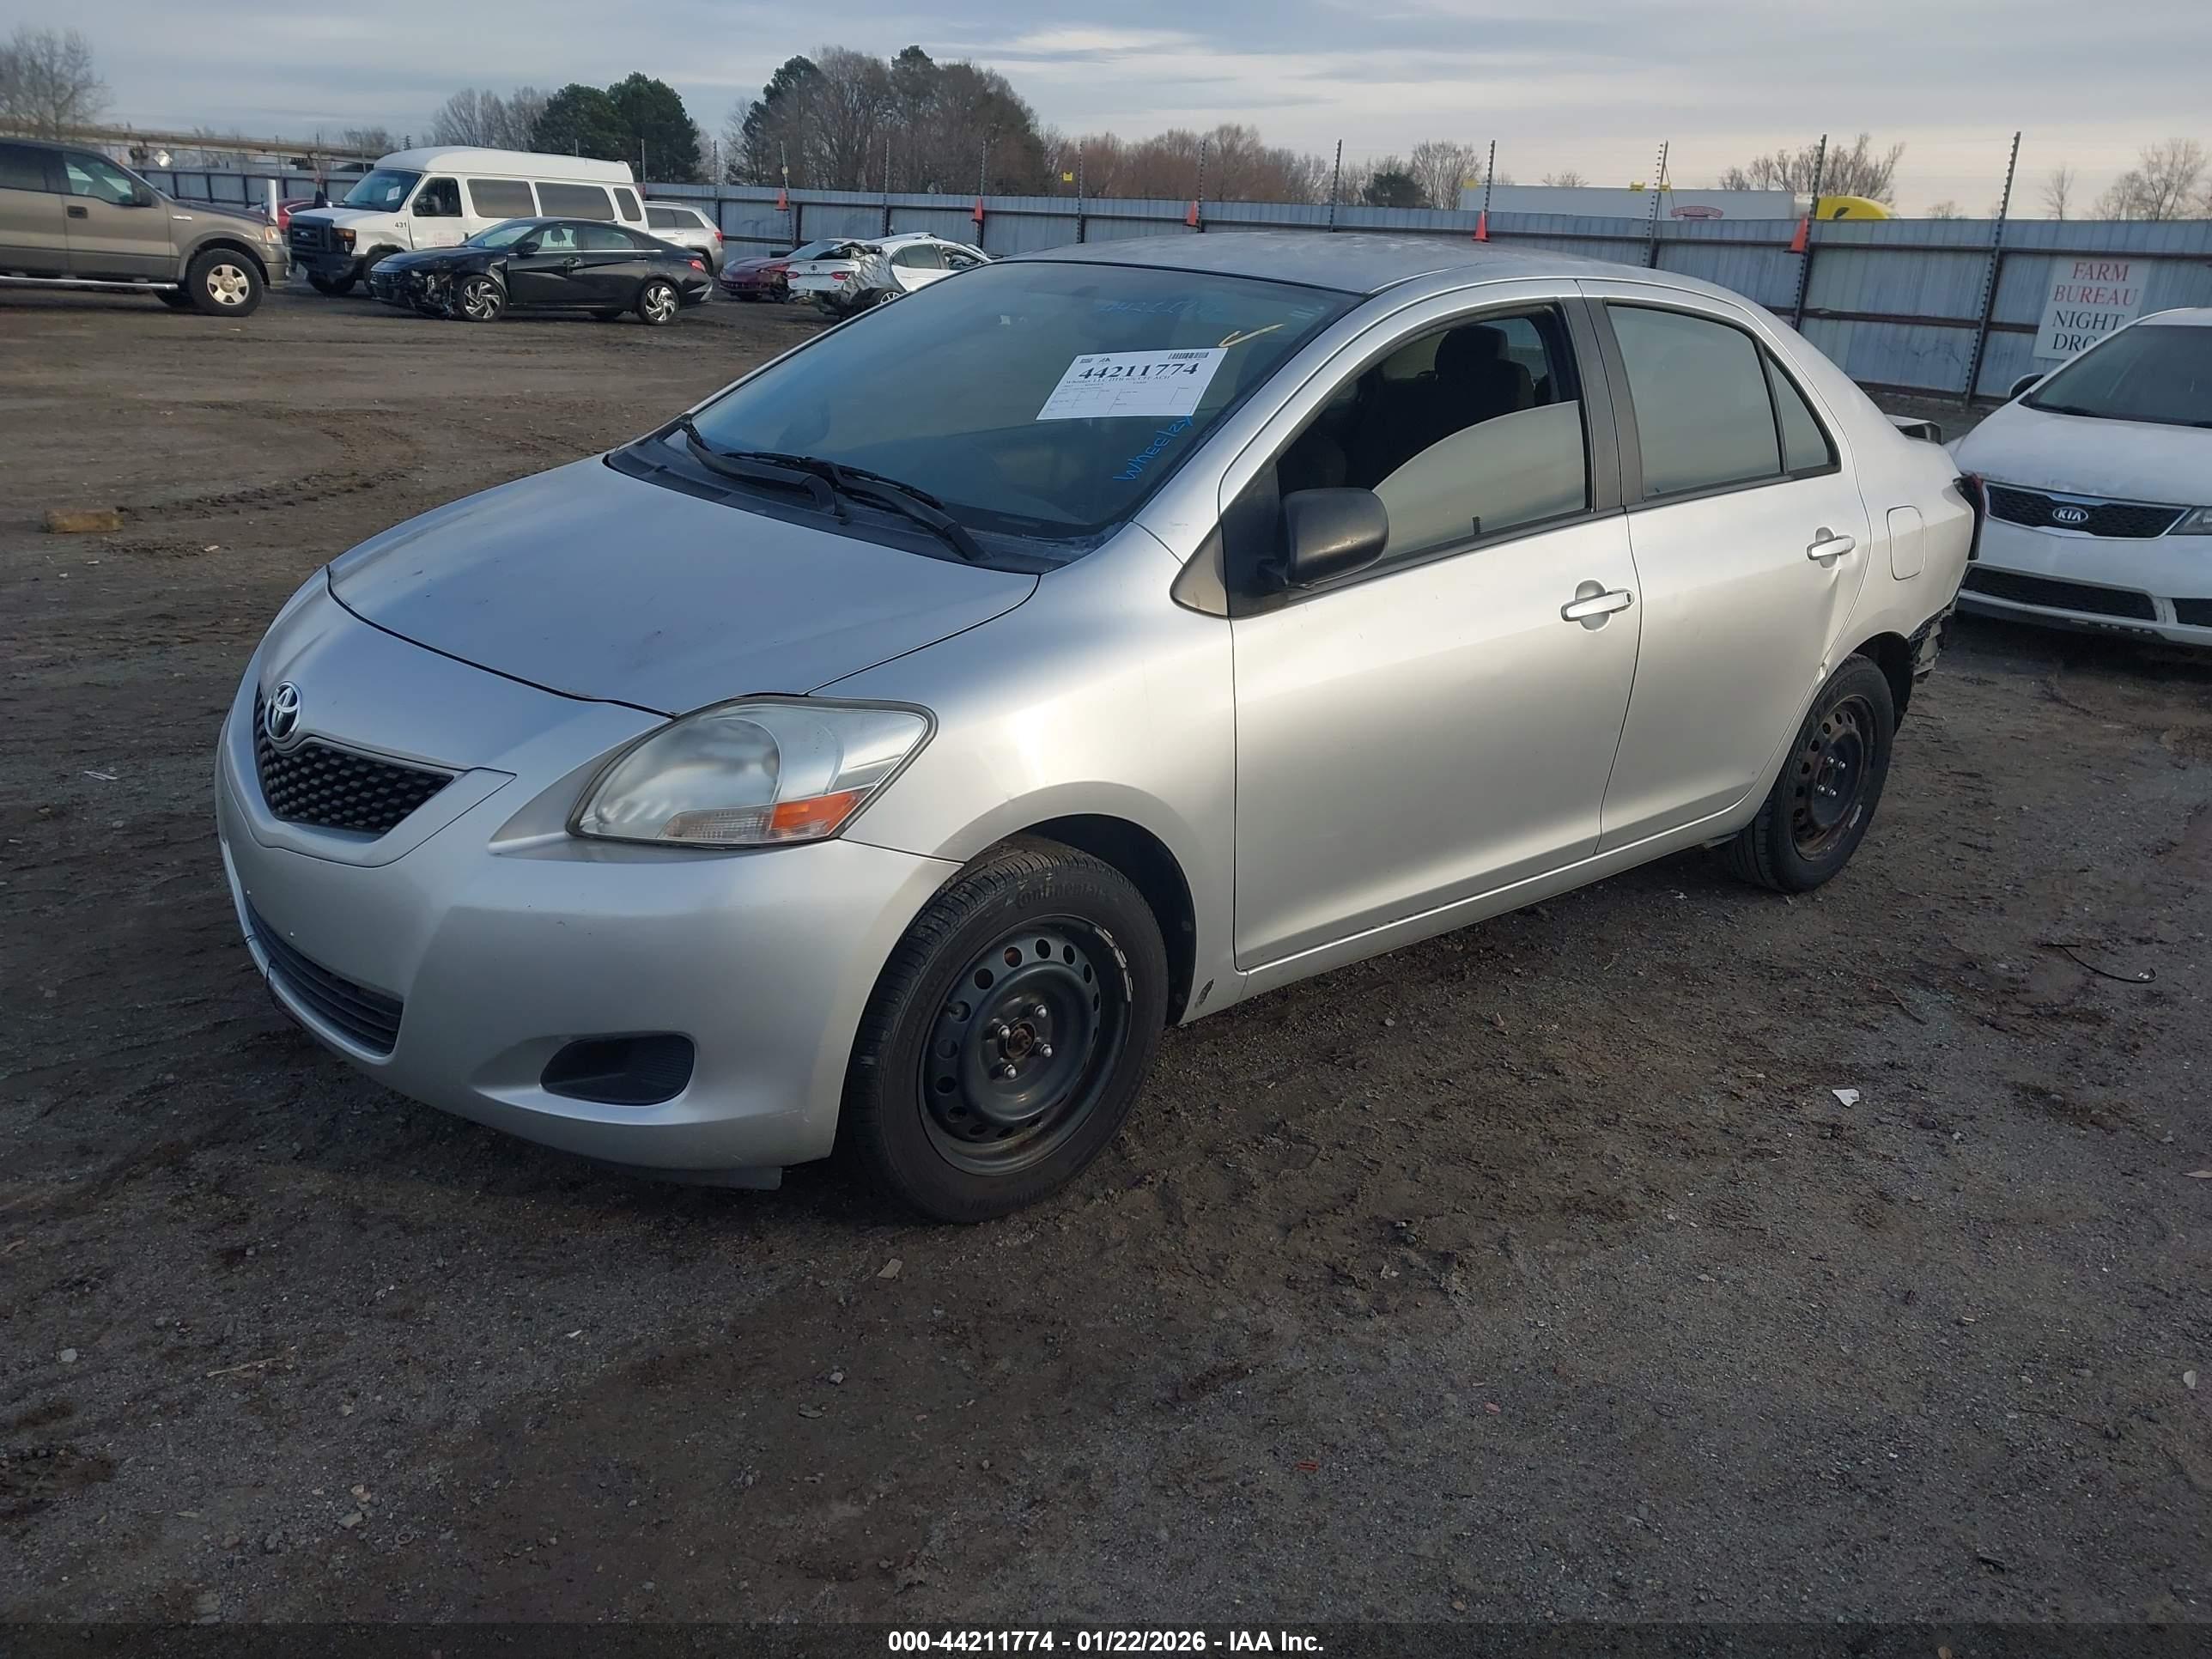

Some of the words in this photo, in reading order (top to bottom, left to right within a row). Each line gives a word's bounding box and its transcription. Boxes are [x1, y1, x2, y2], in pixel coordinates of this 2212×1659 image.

[2072, 262, 2130, 282] FARM
[2054, 284, 2138, 306] BUREAU
[2052, 310, 2124, 331] NIGHT
[2052, 333, 2097, 352] DRO
[1078, 362, 1200, 379] 44211774
[1113, 416, 1194, 480] Wheelzy
[2057, 508, 2081, 522] KIA
